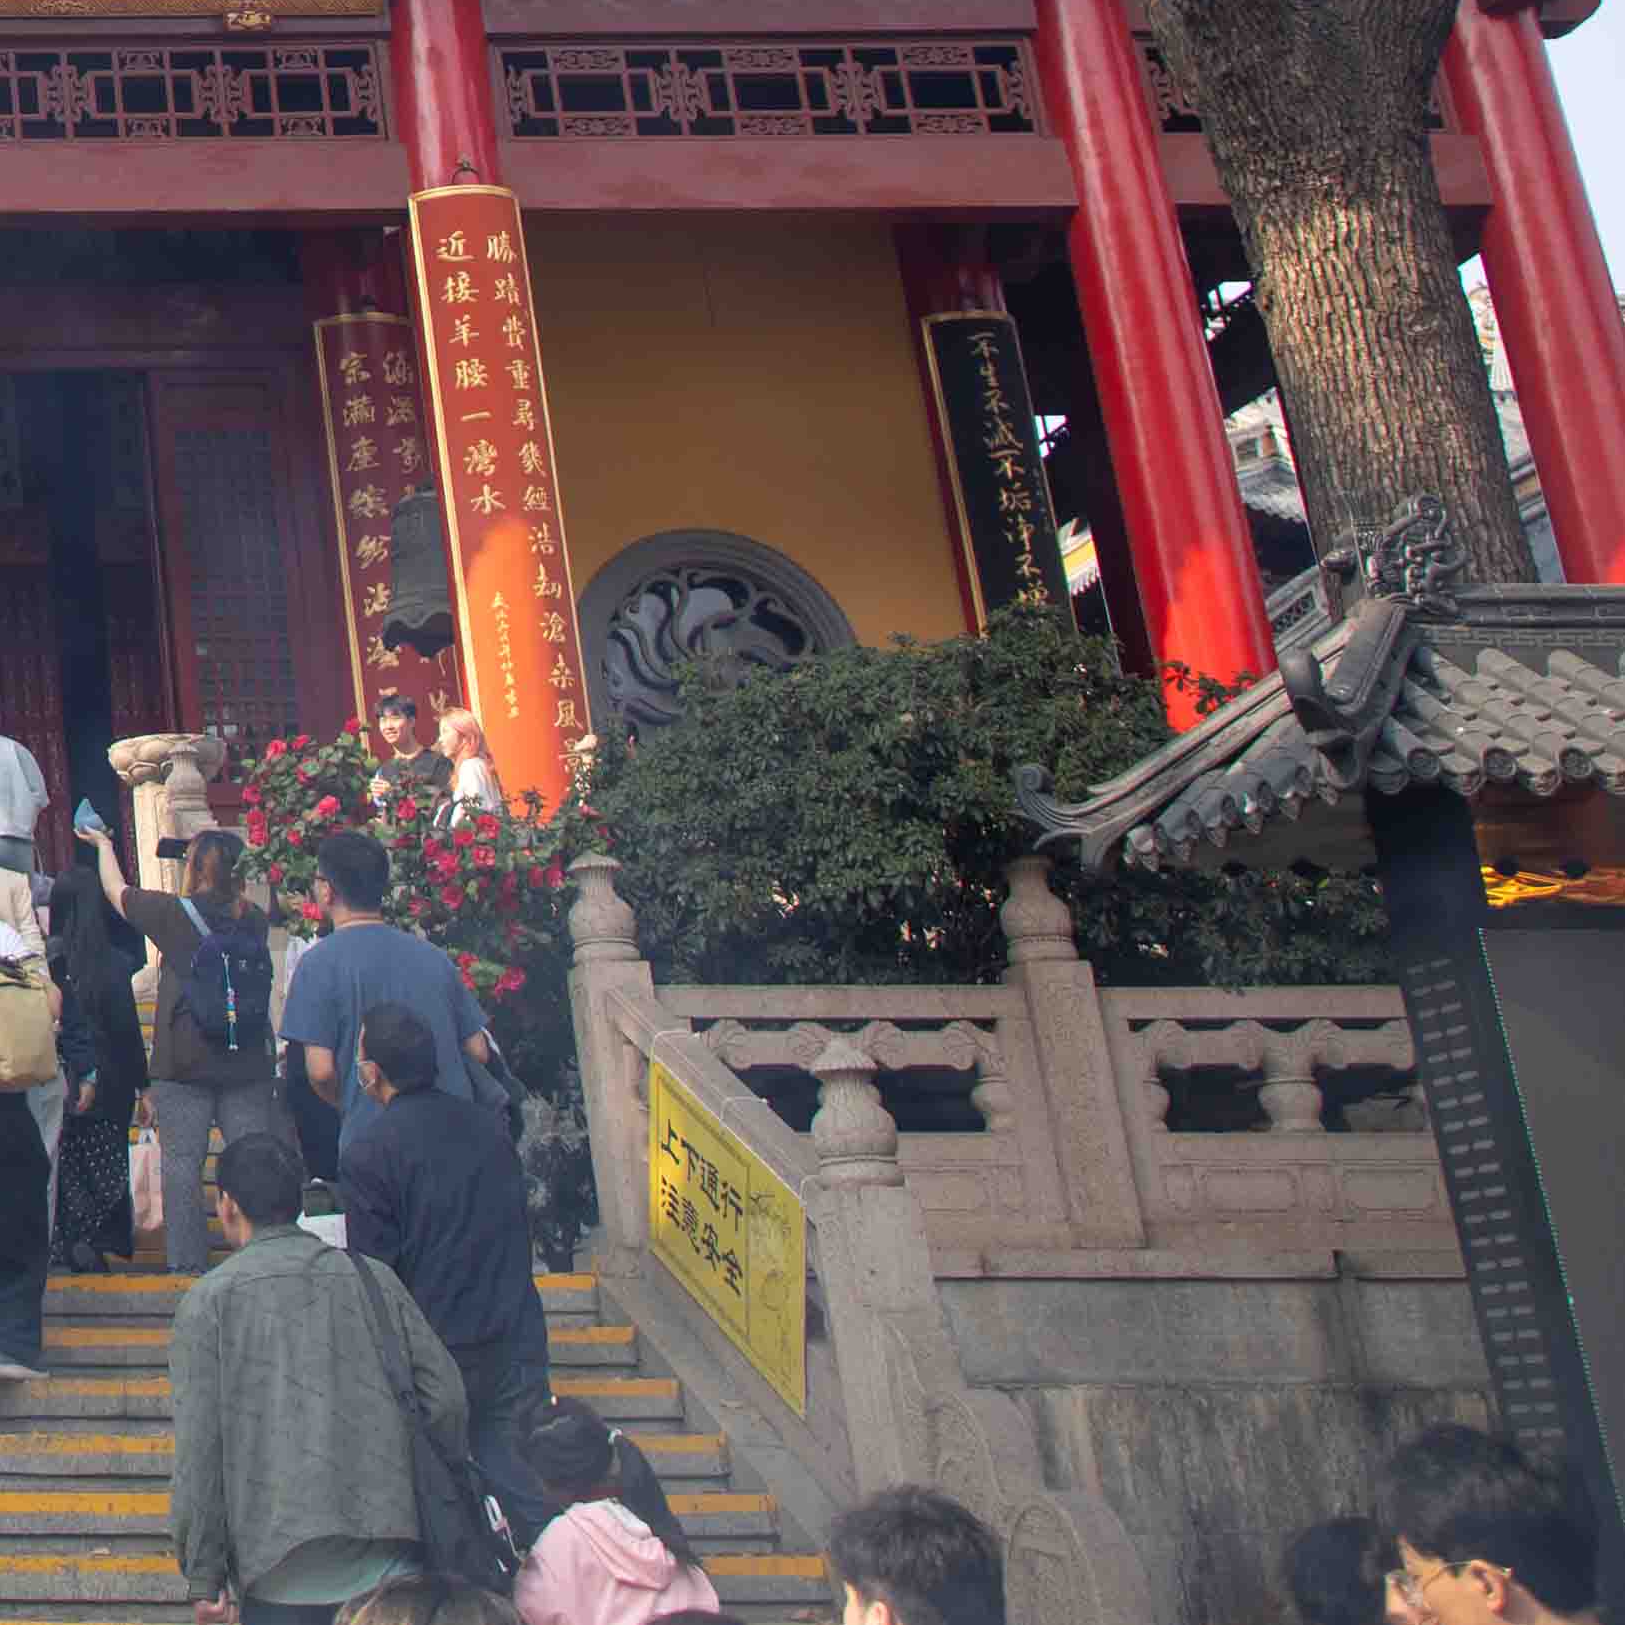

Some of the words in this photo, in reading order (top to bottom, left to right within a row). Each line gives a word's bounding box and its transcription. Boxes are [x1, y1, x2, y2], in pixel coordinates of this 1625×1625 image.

[661, 1118, 743, 1232] 上下通行
[660, 1174, 743, 1297] 注意安全
